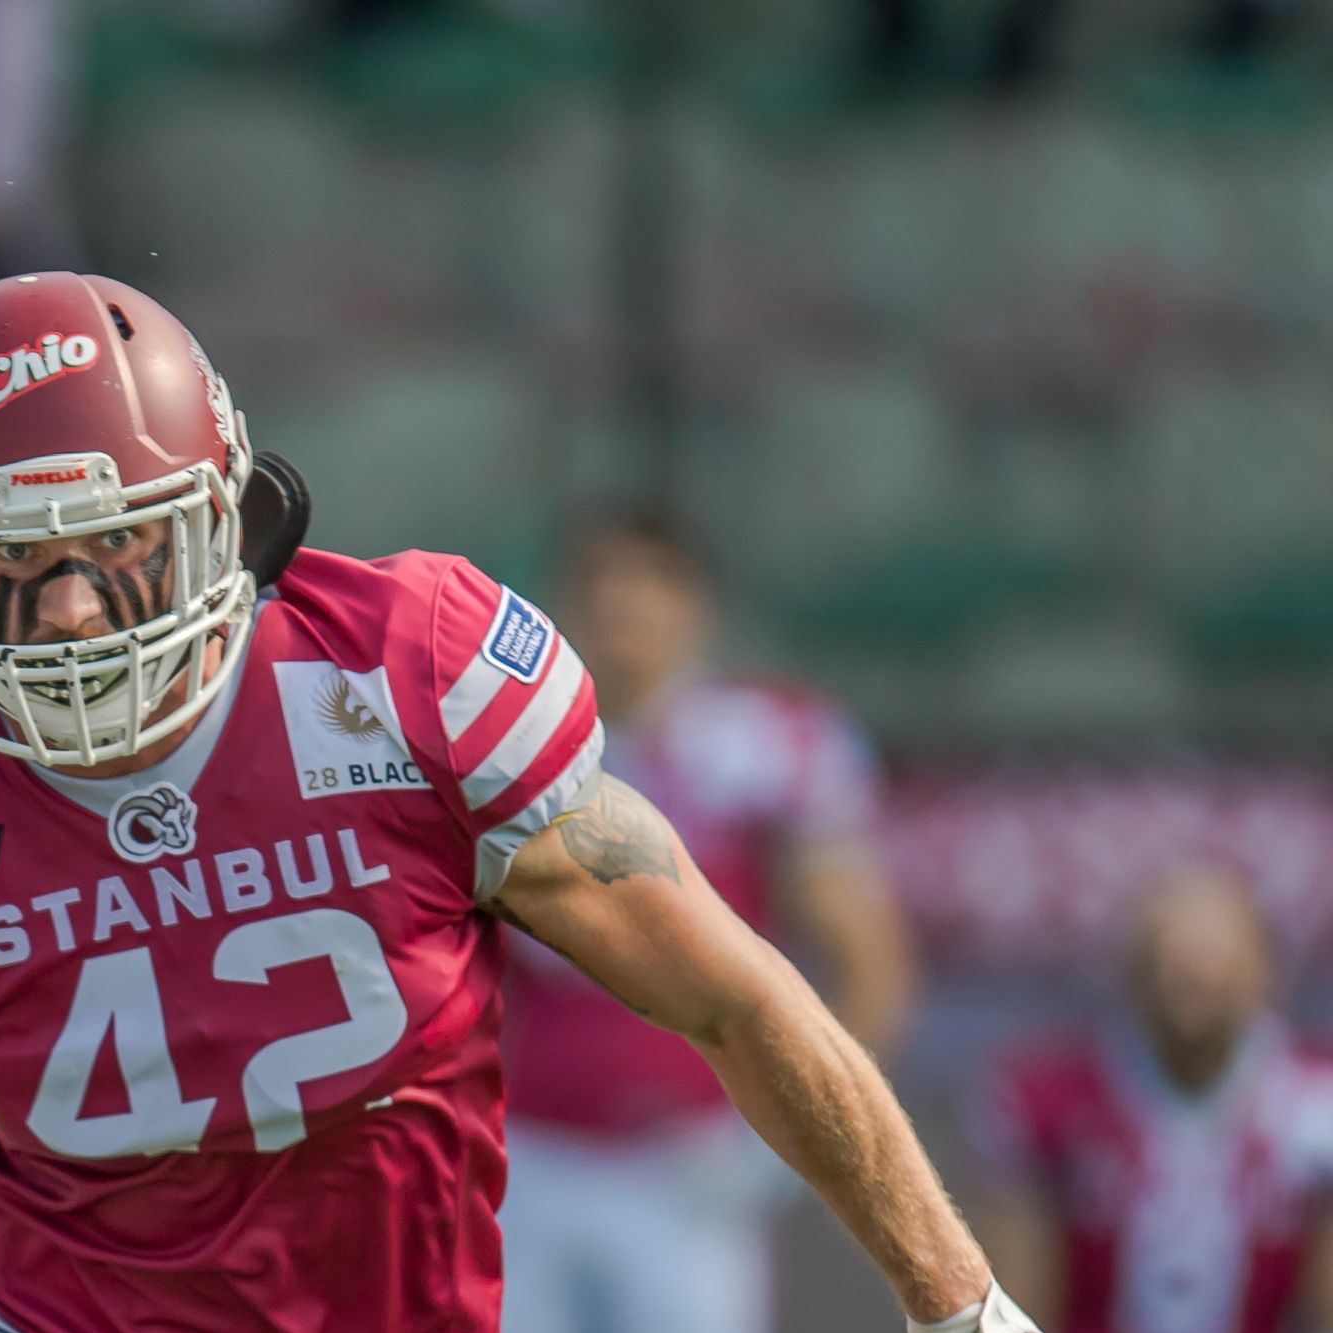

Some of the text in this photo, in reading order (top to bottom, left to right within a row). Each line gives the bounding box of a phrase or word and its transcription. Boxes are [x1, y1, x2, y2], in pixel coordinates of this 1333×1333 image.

[304, 762, 429, 791] 28 BLAC
[25, 908, 408, 1159] 42
